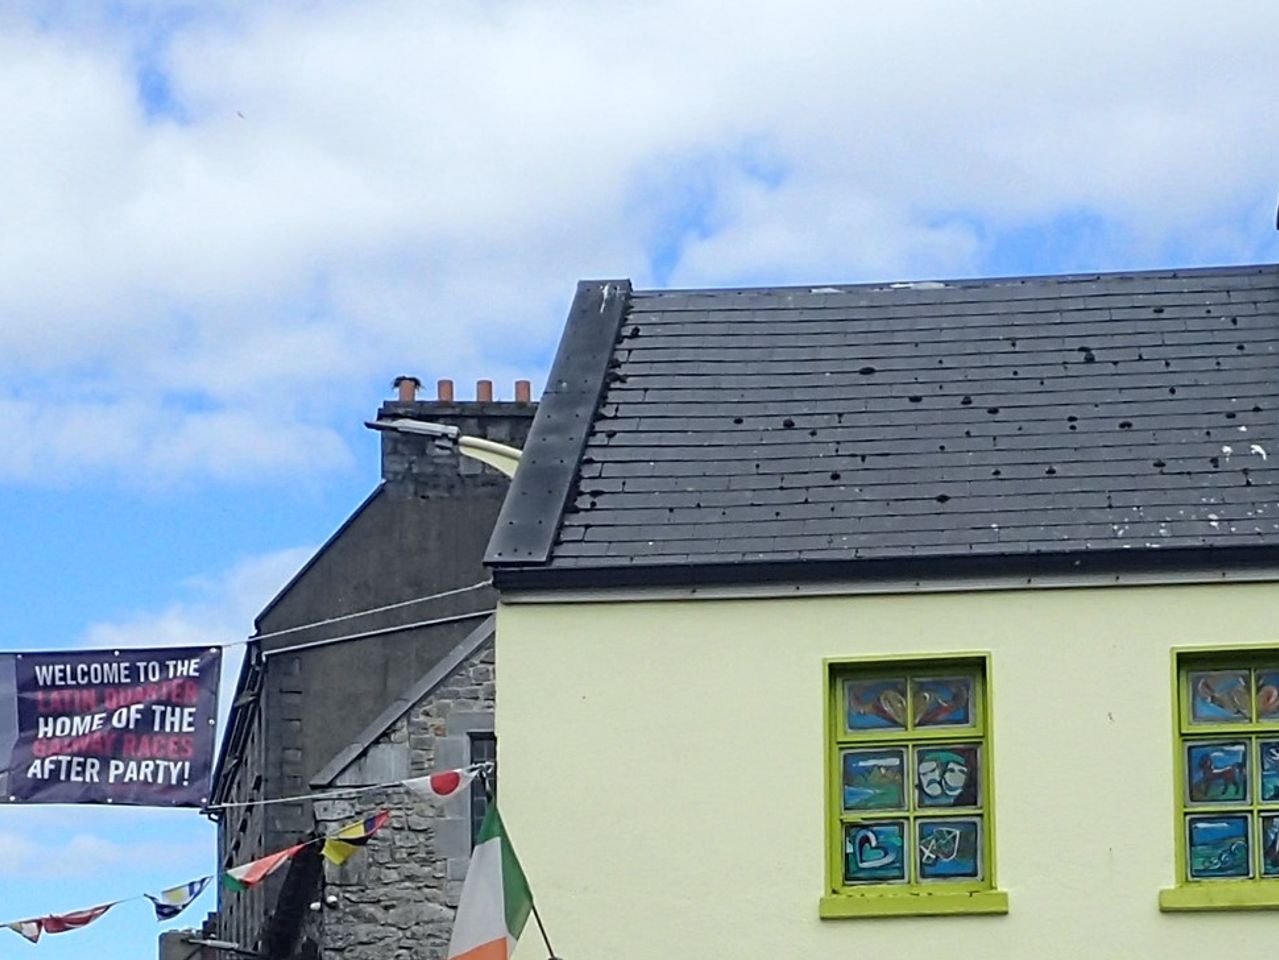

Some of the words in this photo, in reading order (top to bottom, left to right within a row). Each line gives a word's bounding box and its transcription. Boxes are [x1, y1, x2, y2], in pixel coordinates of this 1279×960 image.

[35, 662, 131, 686] WELCOME
[136, 661, 160, 682] TO
[166, 659, 201, 679] THE
[37, 688, 97, 711] LATIN
[104, 679, 199, 709] QUARTER
[38, 713, 107, 738] HOME
[111, 704, 144, 729] OF
[152, 705, 196, 732] THE
[32, 733, 114, 757] GALWAY
[122, 734, 194, 758] RACES
[27, 755, 100, 783] AFTER
[109, 760, 190, 786] PARTY!
